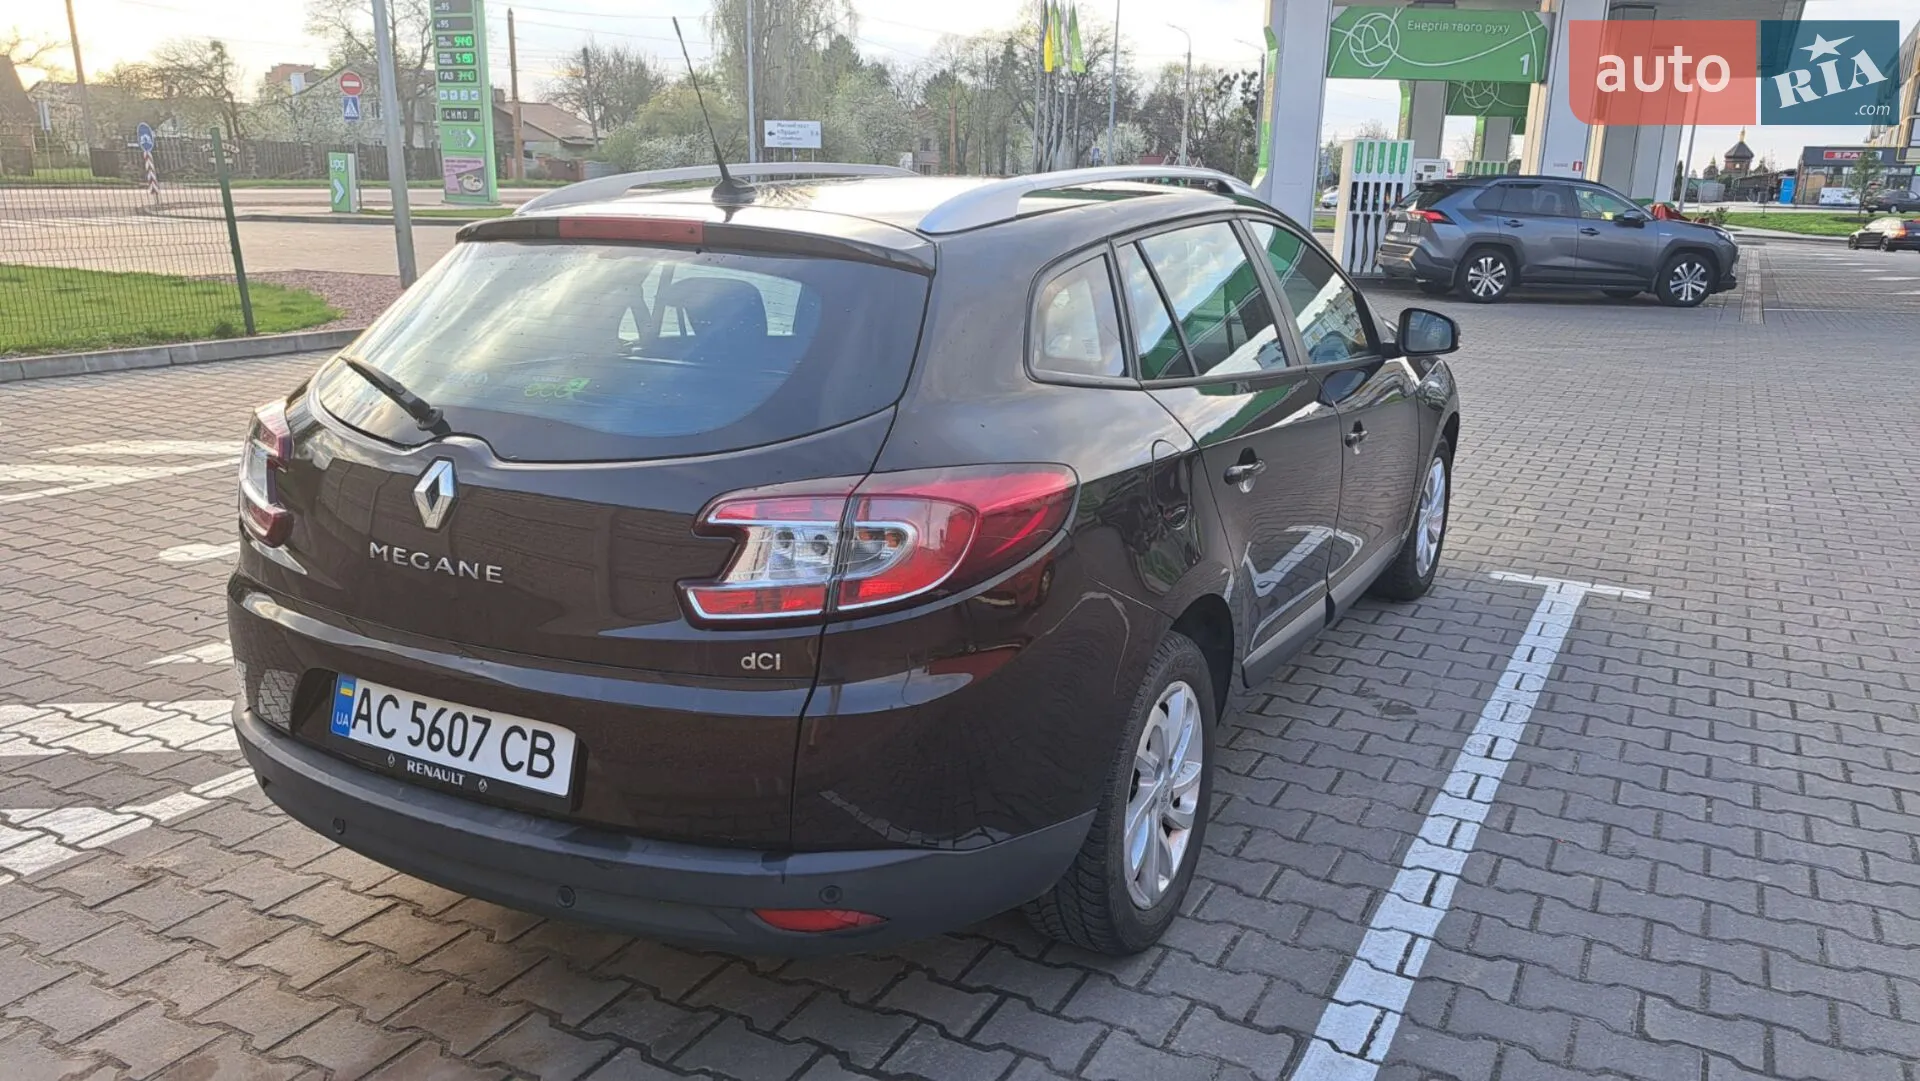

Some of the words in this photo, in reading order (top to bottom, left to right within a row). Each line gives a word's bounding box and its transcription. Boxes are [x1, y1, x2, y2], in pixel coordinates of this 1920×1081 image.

[1407, 20, 1449, 32] Енергія
[1451, 23, 1483, 33] твого
[1484, 24, 1511, 34] руху
[440, 71, 454, 81] ГАЗ
[1519, 53, 1531, 76] 1
[369, 541, 504, 583] MEGANE
[336, 711, 350, 727] UA
[351, 687, 400, 739] AC
[407, 700, 492, 763] 5607
[500, 725, 556, 779] CB
[406, 759, 466, 786] RENAULT
